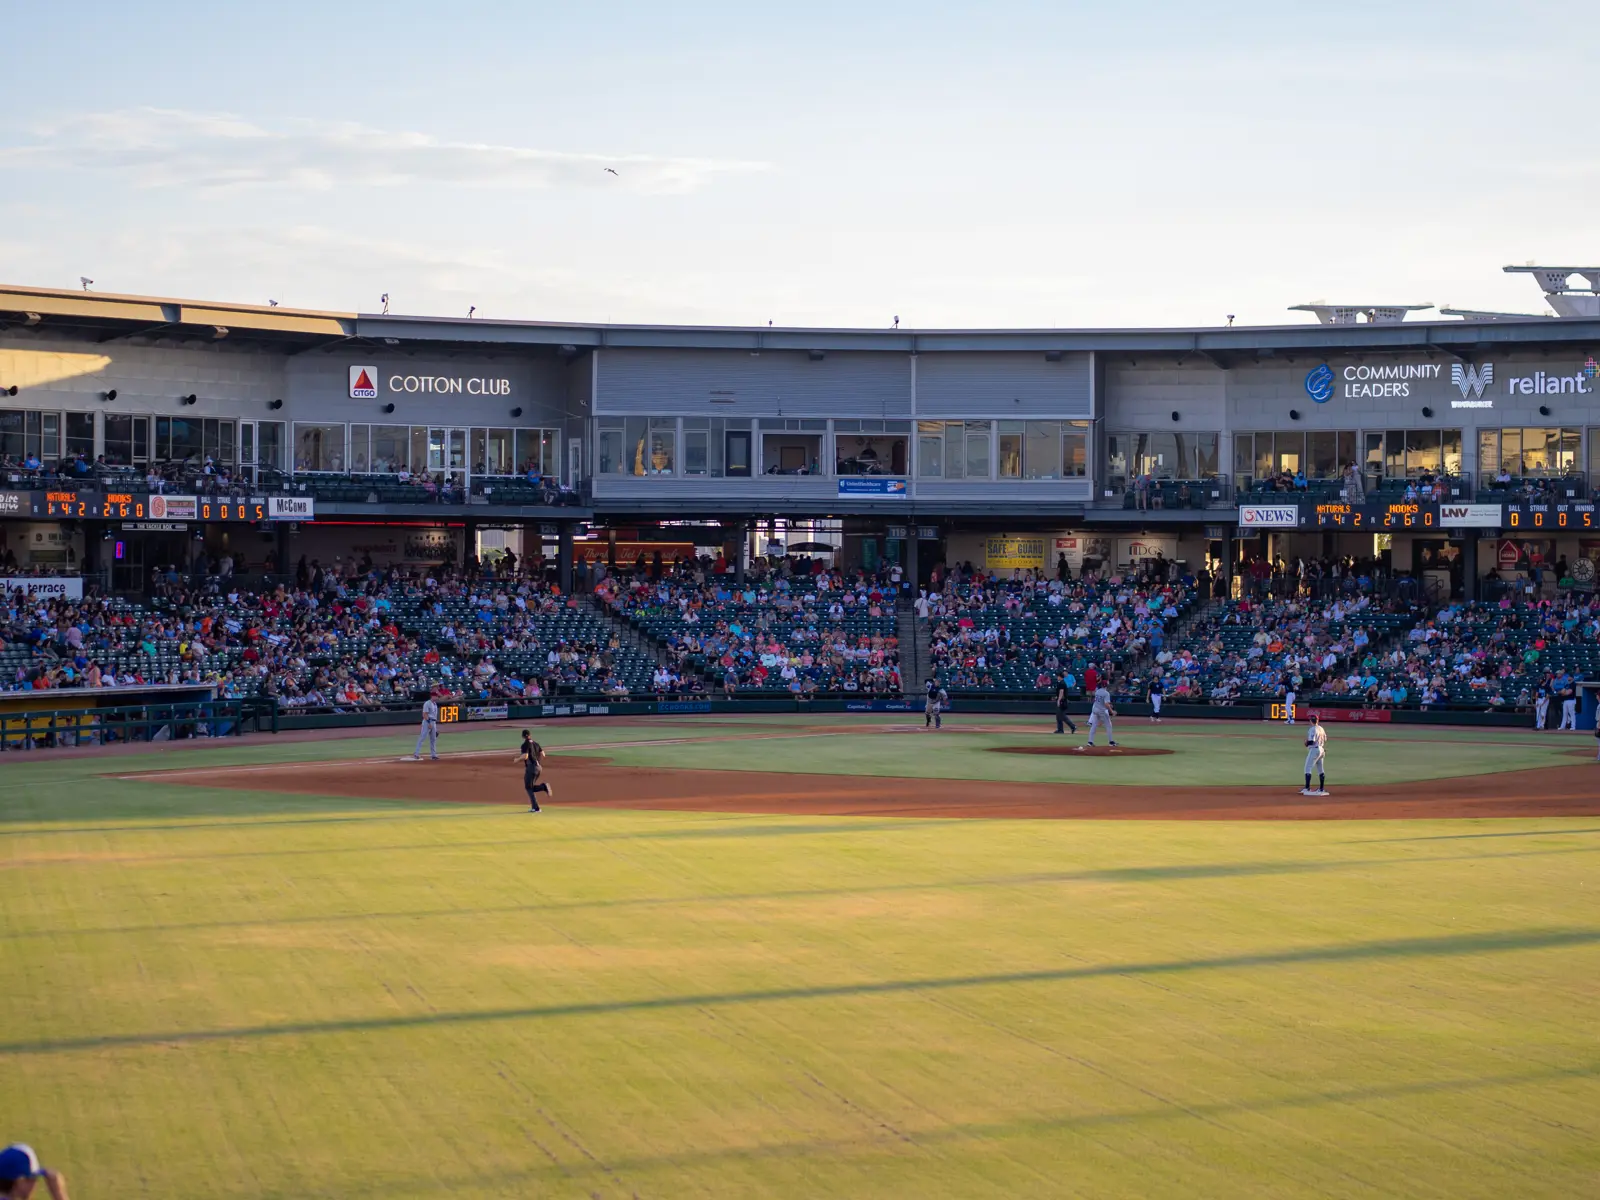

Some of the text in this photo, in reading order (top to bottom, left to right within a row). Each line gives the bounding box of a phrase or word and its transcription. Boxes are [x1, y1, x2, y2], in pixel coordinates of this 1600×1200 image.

[1343, 364, 1441, 380] COMMUNITY
[389, 375, 511, 395] COTTON CLUB
[1345, 382, 1410, 397] LEADERS
[353, 389, 375, 397] CITGO
[107, 493, 132, 503] HOOKS
[61, 502, 68, 515] 4
[78, 502, 85, 516] 2
[103, 502, 110, 517] 2
[120, 503, 127, 517] 6
[136, 503, 143, 517] 0
[203, 504, 210, 519] 0
[221, 504, 228, 519] 0
[238, 505, 245, 519] 0
[255, 505, 263, 519] 5
[1316, 504, 1351, 513] NATURALS
[1389, 504, 1419, 513] HOOKS
[1441, 507, 1469, 518] LNV
[1333, 513, 1341, 525] 4
[1353, 513, 1361, 526] 2
[1384, 513, 1391, 526] 2
[1404, 513, 1412, 526] 6
[1424, 512, 1432, 526] 0
[1510, 513, 1591, 527] 0 0 0 5
[891, 528, 907, 537] 119
[987, 543, 1007, 554] SAFE
[1017, 543, 1043, 554] GUARD
[28, 582, 66, 593] terrace
